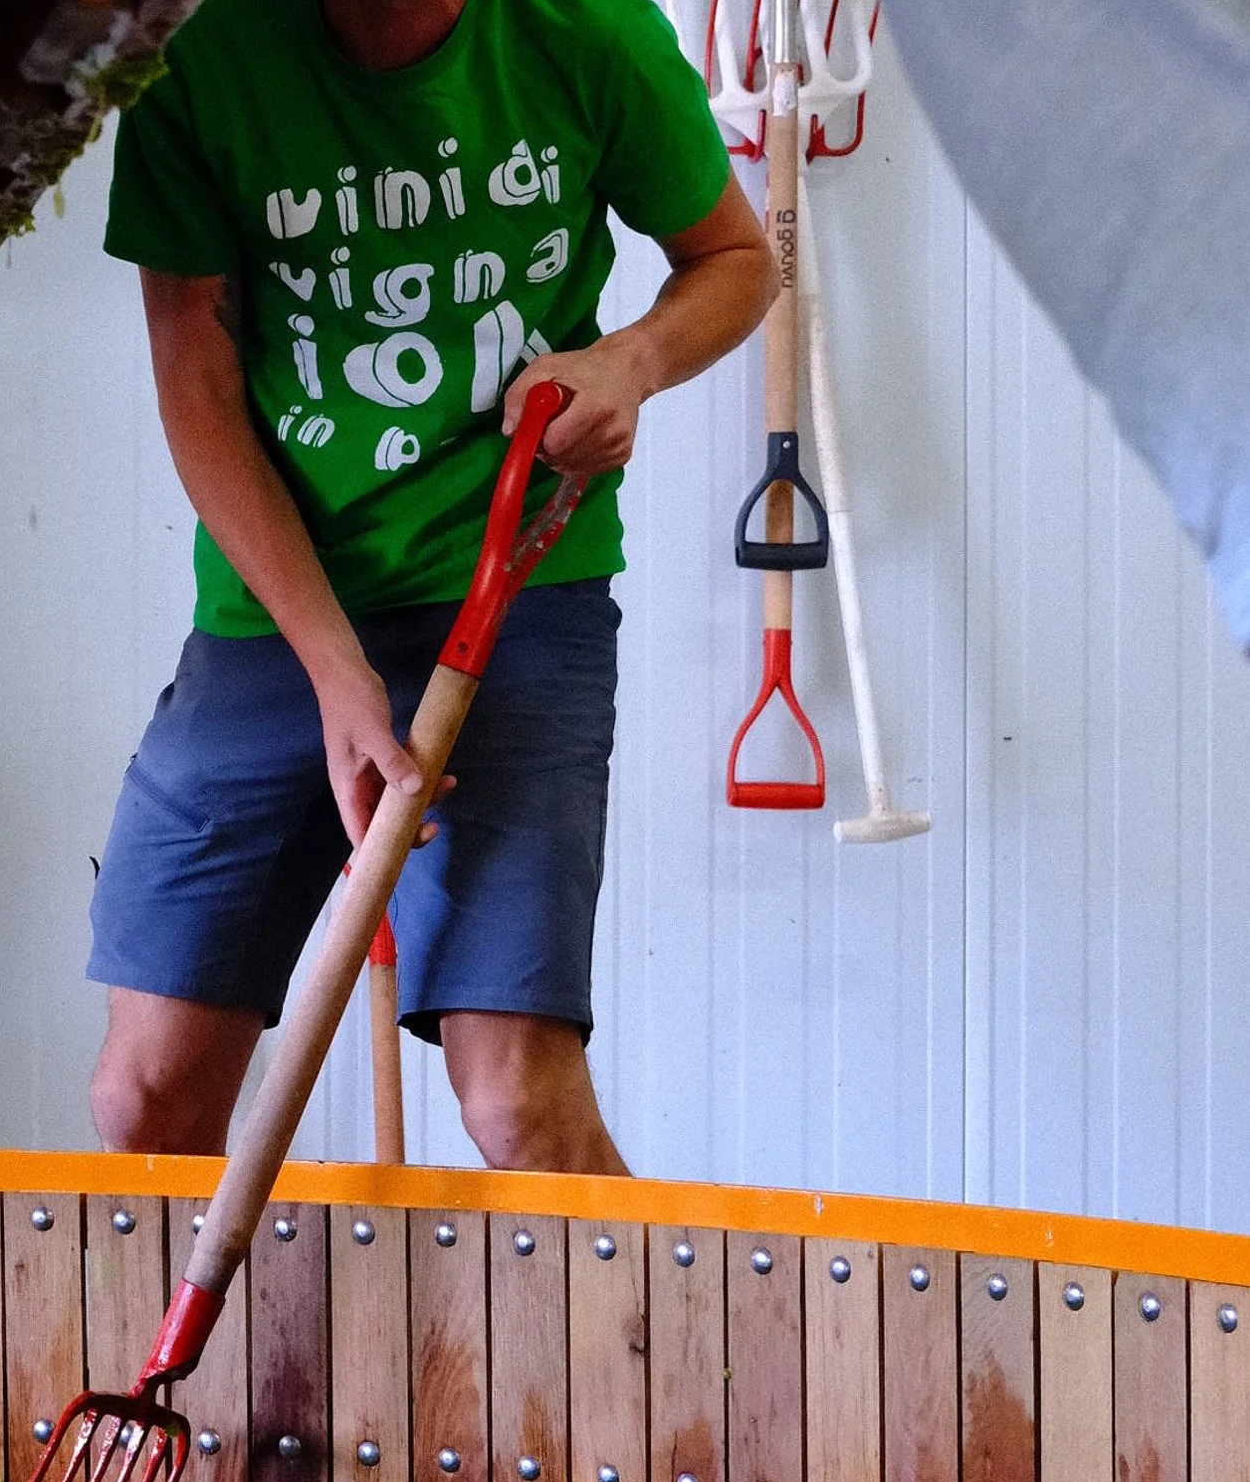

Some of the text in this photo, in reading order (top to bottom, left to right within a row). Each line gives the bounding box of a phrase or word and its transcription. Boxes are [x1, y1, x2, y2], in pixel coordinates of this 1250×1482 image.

[489, 139, 561, 206] di
[269, 228, 569, 327] vigna
[277, 405, 335, 449] in
